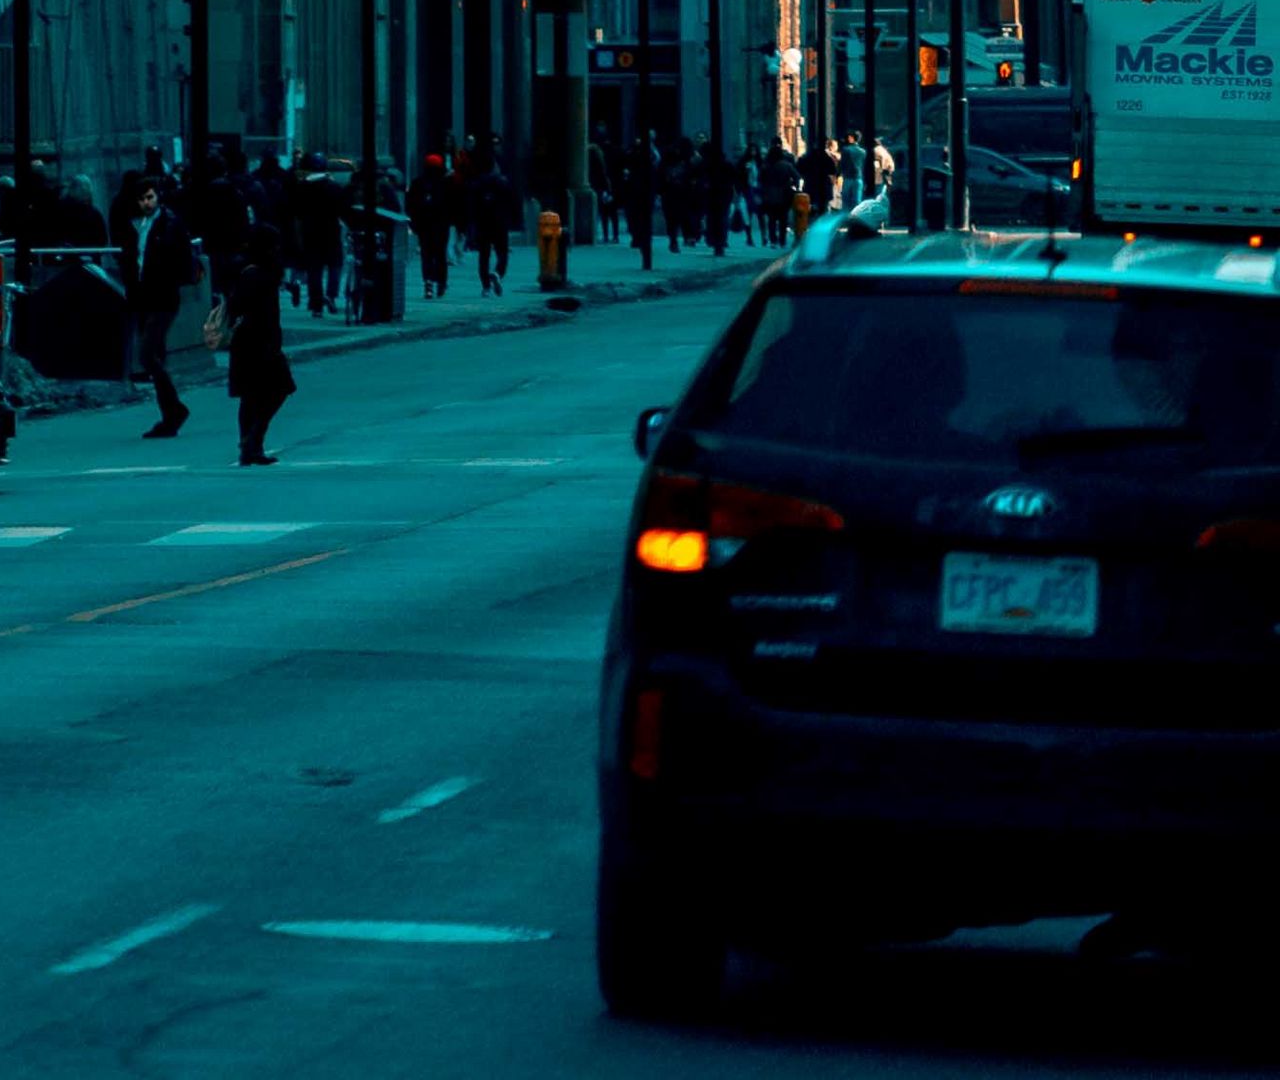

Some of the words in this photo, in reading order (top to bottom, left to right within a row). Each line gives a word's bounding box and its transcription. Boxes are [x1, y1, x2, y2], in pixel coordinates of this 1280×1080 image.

[1115, 44, 1275, 76] Mackie
[1115, 73, 1184, 85] MOVING
[1191, 75, 1274, 88] SYSTEMS
[992, 494, 1042, 517] KIA
